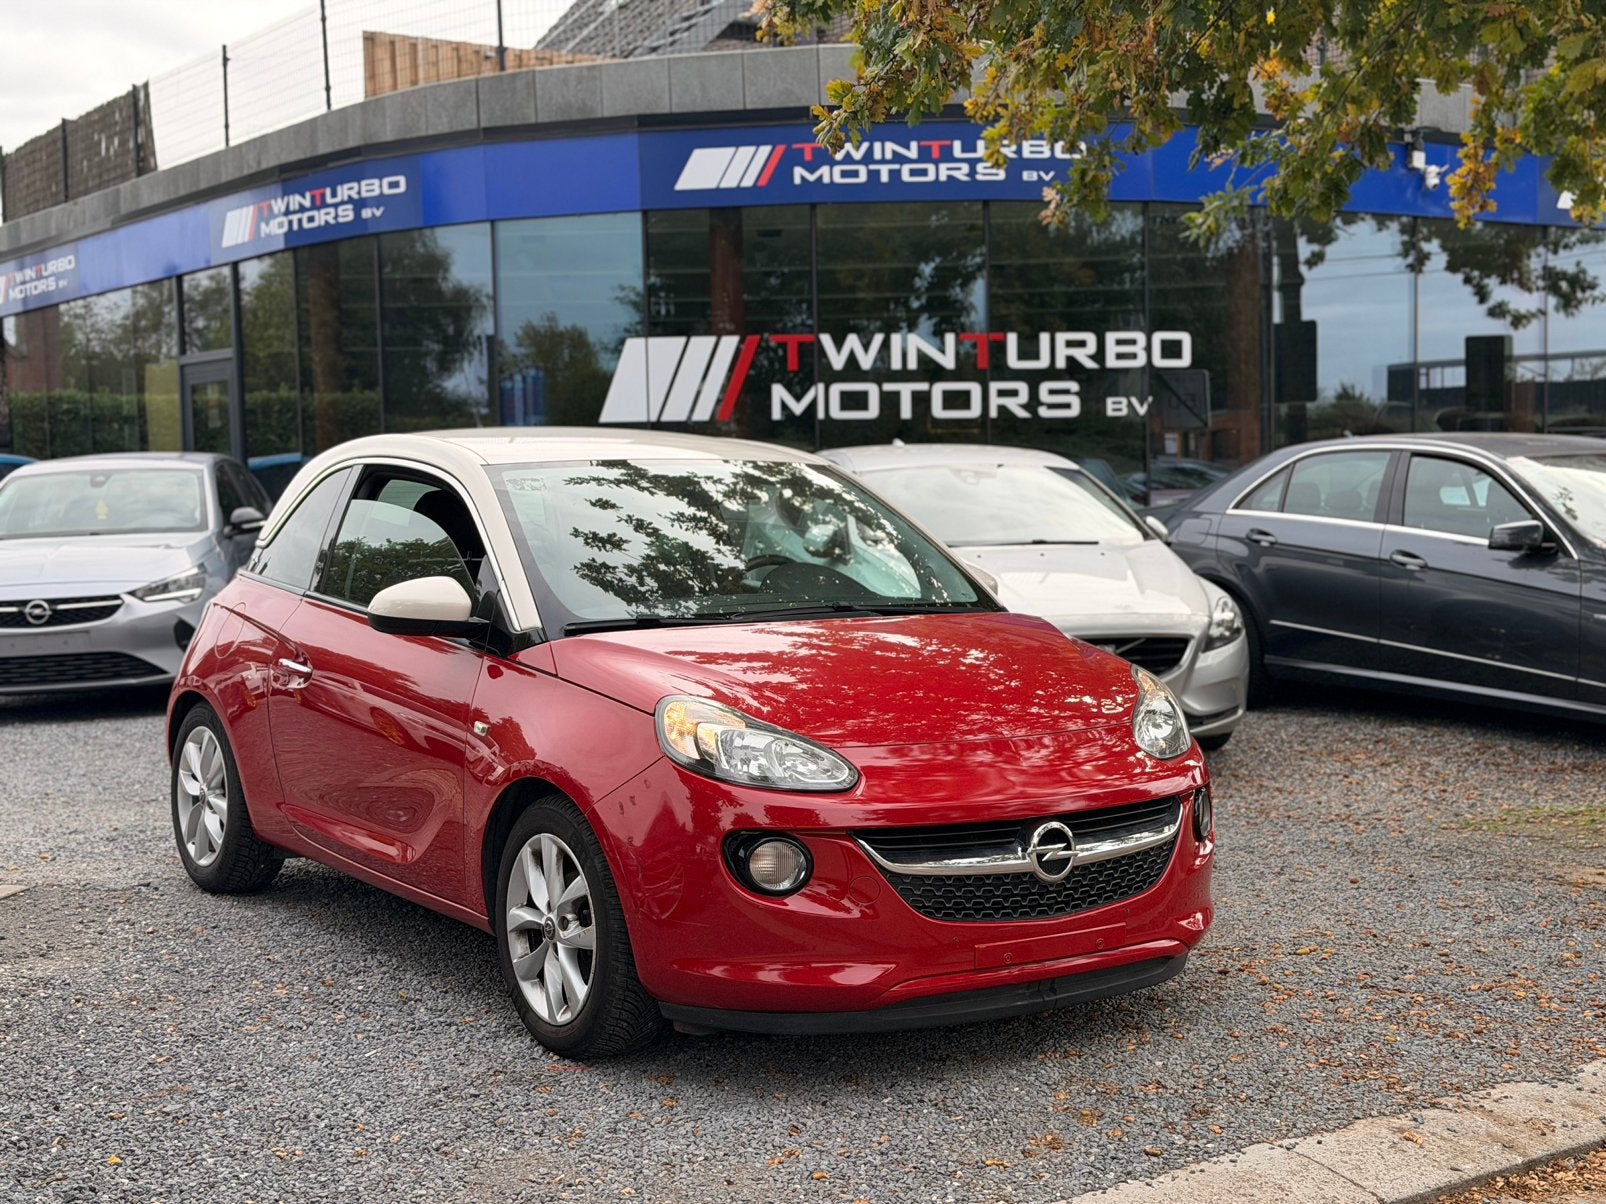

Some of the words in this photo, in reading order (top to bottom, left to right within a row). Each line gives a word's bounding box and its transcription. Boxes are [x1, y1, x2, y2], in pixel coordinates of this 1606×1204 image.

[793, 162, 1006, 185] MOTORS
[1022, 170, 1056, 182] BV
[259, 174, 408, 218] TWINTURBO
[260, 204, 355, 238] MOTORS
[361, 206, 385, 219] BV
[9, 276, 57, 302] MOTORS
[770, 331, 1193, 371] TWINTURBO
[770, 380, 1082, 421] MOTORS
[1105, 395, 1154, 417] BV
